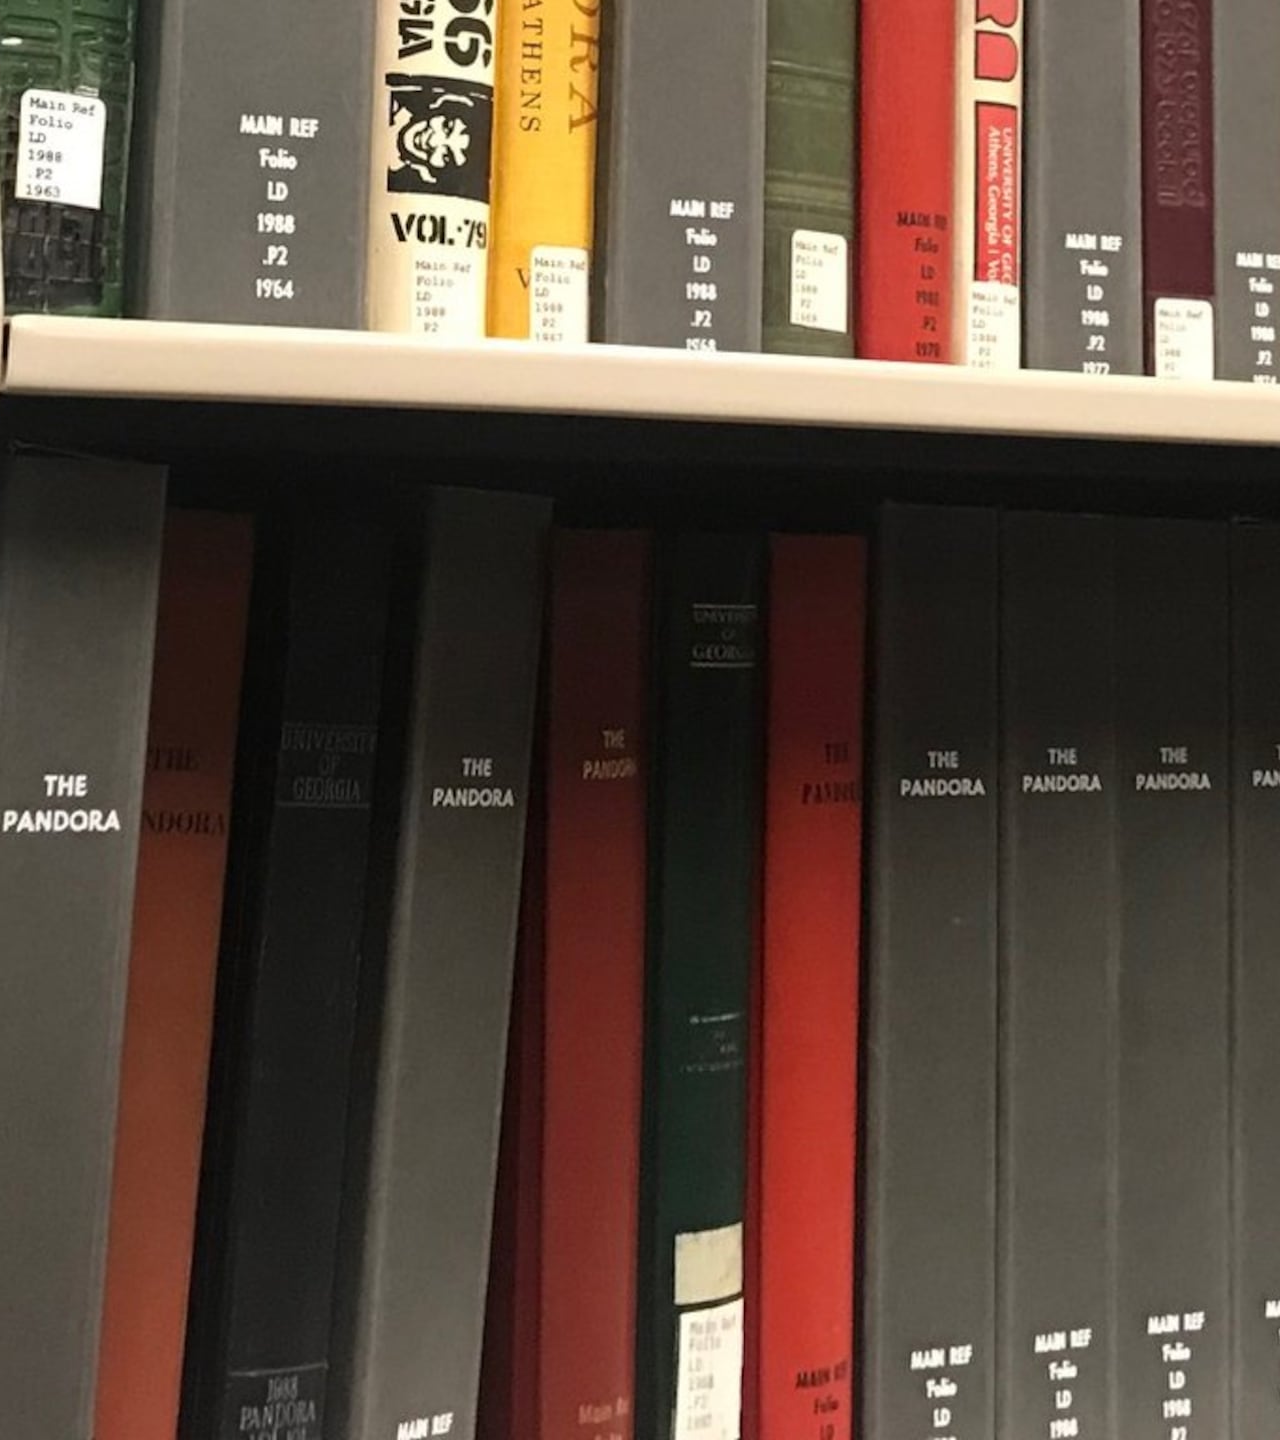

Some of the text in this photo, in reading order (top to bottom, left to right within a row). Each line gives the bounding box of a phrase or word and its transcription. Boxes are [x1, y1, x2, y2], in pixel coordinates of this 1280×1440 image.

[29, 97, 96, 117] Main Ref
[29, 115, 74, 131] Folio
[240, 114, 320, 138] MAIN REF
[29, 132, 46, 144] LD
[28, 150, 62, 164] 1988
[259, 149, 297, 170] Folio
[26, 184, 61, 199] 1963
[267, 182, 288, 202] LD
[257, 213, 295, 235] 1988
[255, 278, 294, 300] 1964
[462, 758, 492, 777] THE
[928, 752, 959, 768] THE
[44, 774, 87, 796] THE
[901, 779, 986, 796] PANDORA
[432, 788, 514, 807] PANDORA
[2, 810, 120, 833] PANDORA
